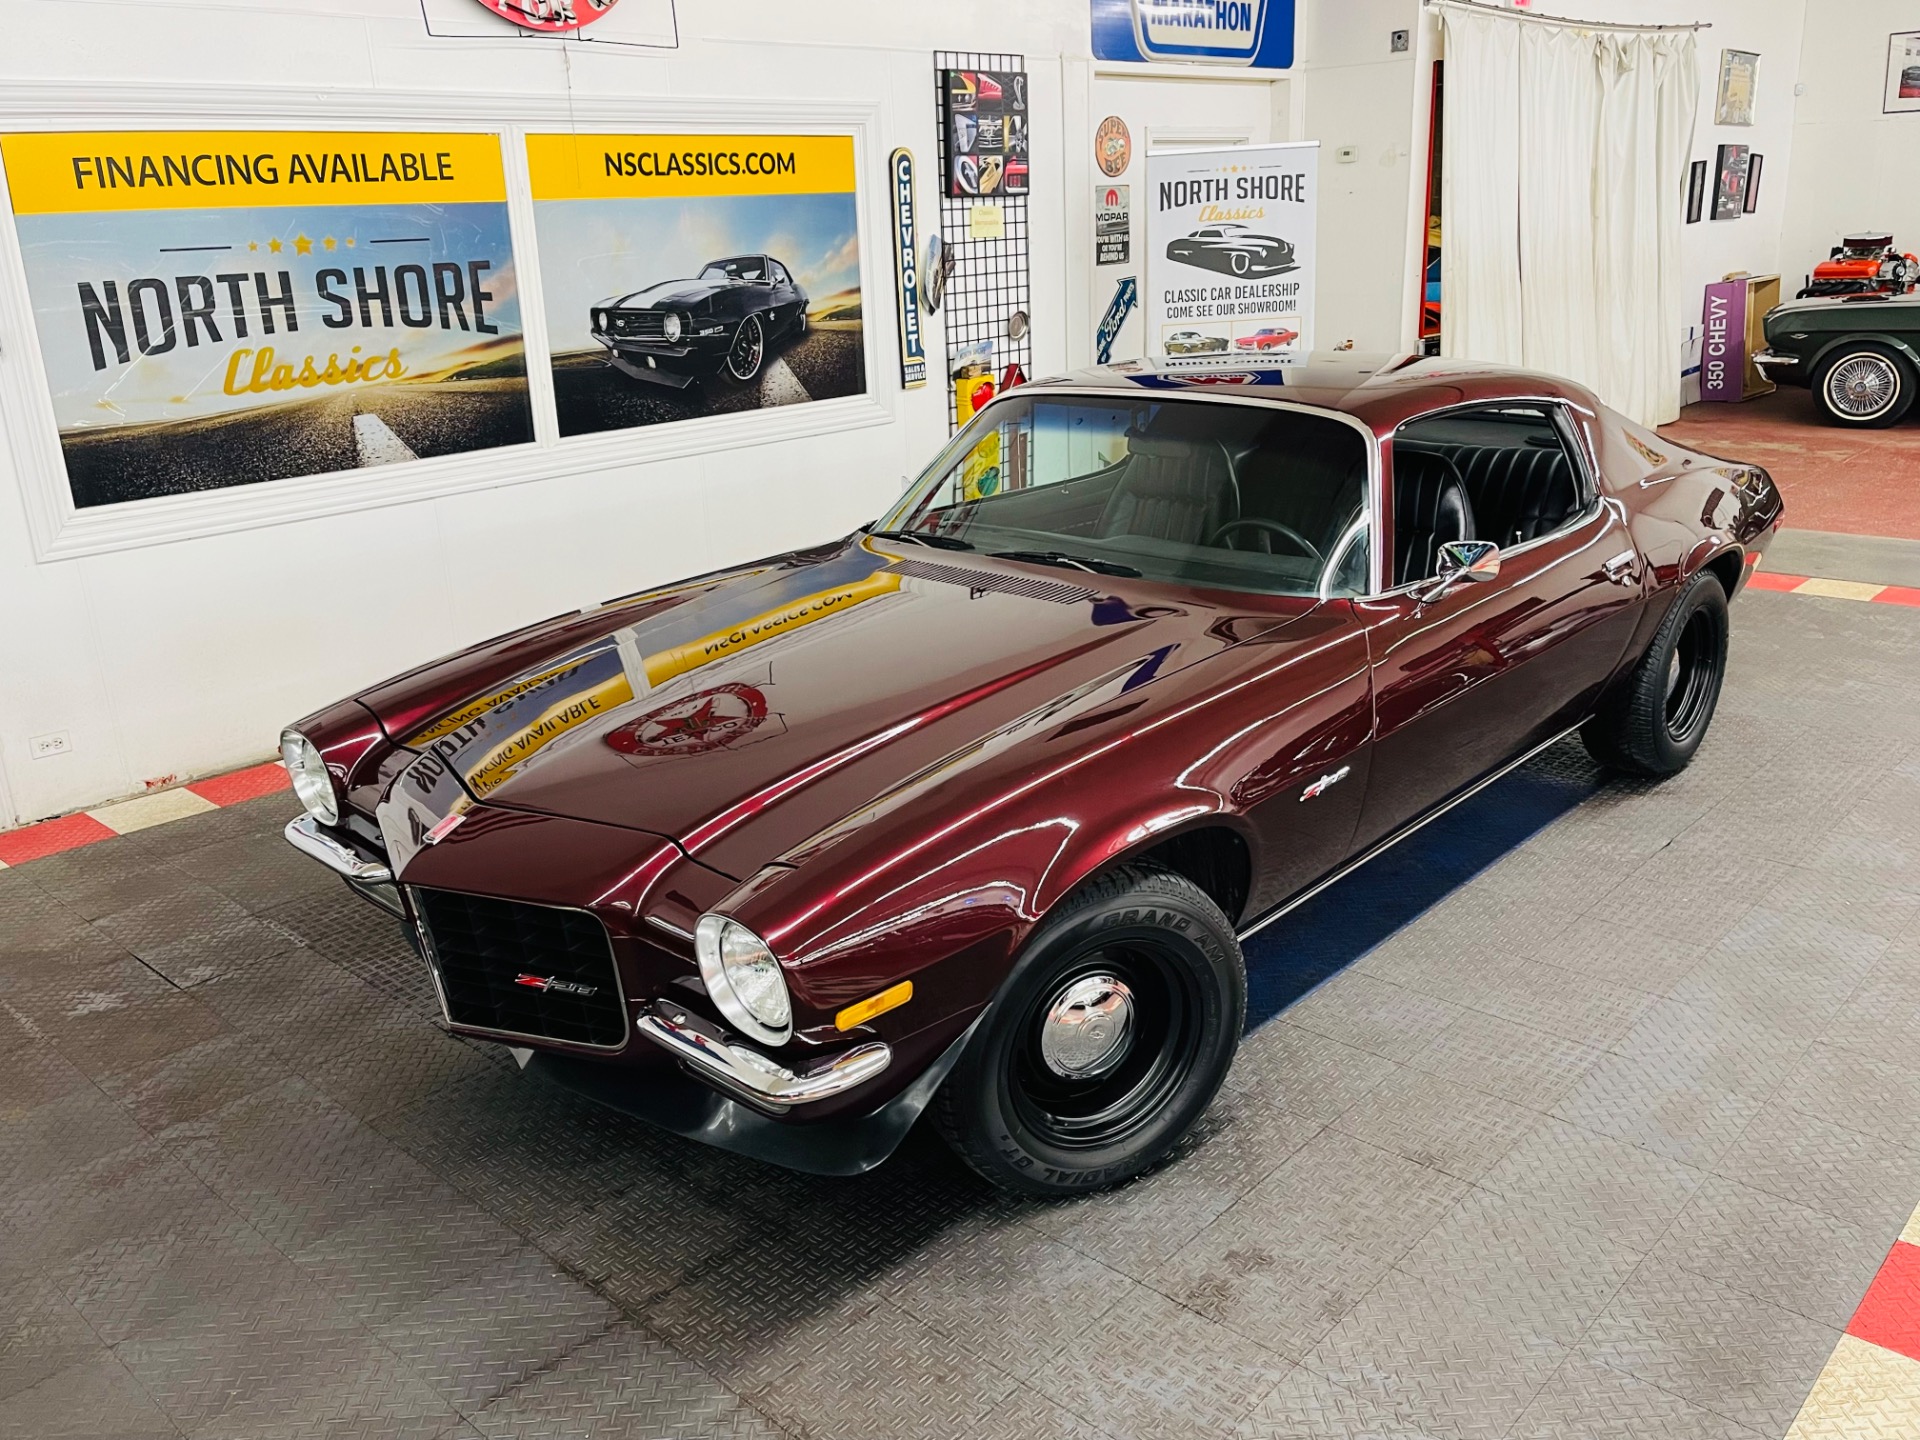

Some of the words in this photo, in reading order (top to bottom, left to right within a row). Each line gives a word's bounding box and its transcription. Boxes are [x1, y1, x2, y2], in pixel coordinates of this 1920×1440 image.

[72, 153, 279, 190] FINANCING
[288, 152, 454, 184] AVAILABLE
[604, 152, 796, 177] NSCLASSICS.COM
[1104, 151, 1126, 174] BEE
[1159, 177, 1229, 211] NORTH
[1236, 173, 1305, 203] SHORE
[1096, 212, 1129, 221] MOPAR
[1199, 204, 1265, 223] Classics
[898, 160, 918, 353] CHEVROLET
[1164, 288, 1207, 304] CLASSIC
[1211, 287, 1231, 301] CAR
[1235, 283, 1300, 300] DEALERSHIP
[1167, 306, 1193, 319] COME
[1197, 304, 1213, 317] SEE
[1216, 303, 1236, 315] OUR
[1238, 300, 1296, 314] SHOWROOM!
[77, 269, 299, 372] NORTH
[315, 260, 499, 335] SHORE
[1105, 298, 1127, 342] Ford
[1708, 295, 1728, 356] CHEVY
[223, 346, 409, 396] Classics
[1707, 361, 1725, 390] 350
[1102, 909, 1192, 932] GRAND
[1194, 933, 1224, 963] AM
